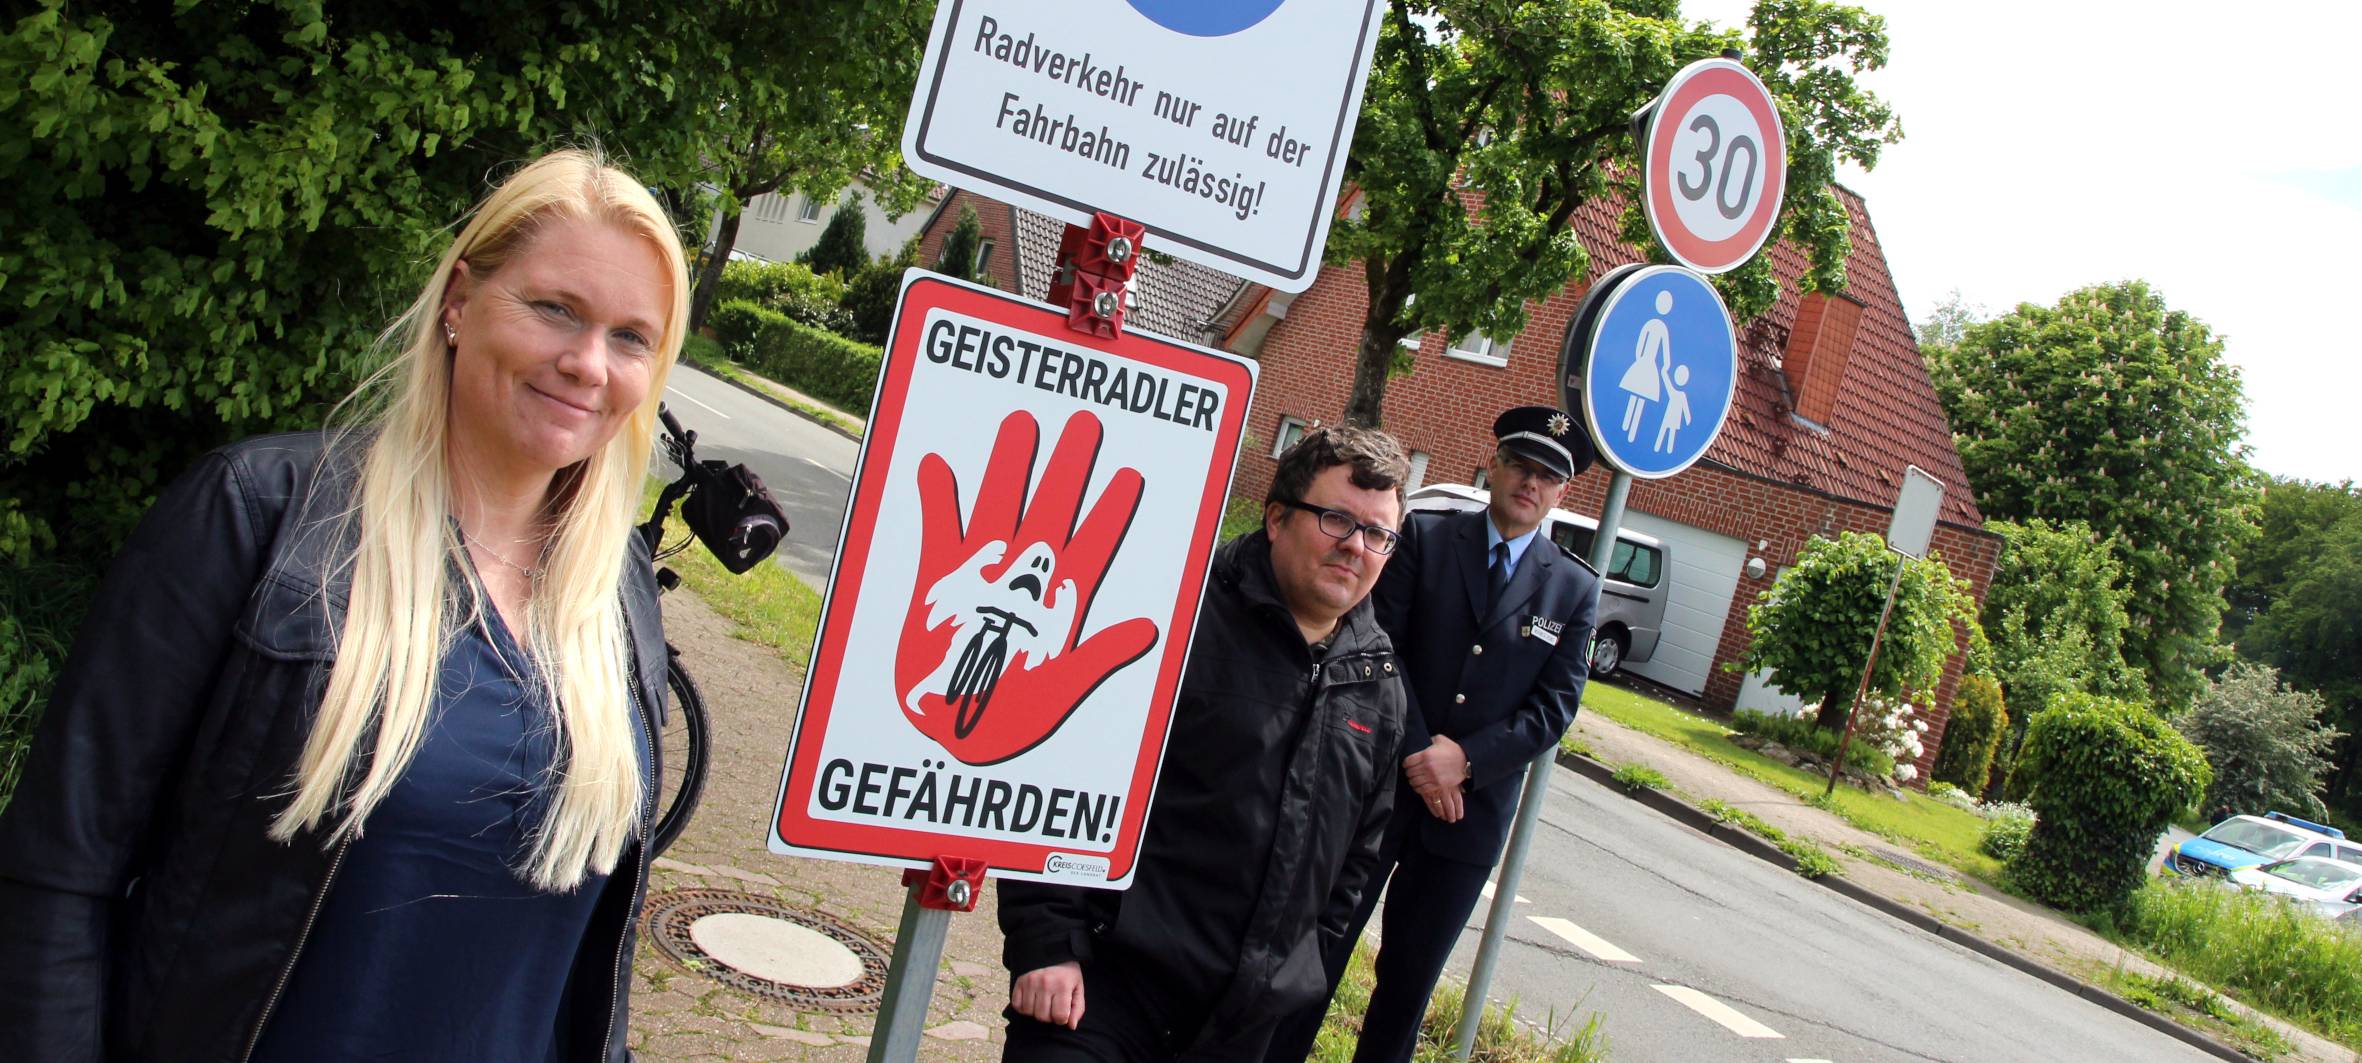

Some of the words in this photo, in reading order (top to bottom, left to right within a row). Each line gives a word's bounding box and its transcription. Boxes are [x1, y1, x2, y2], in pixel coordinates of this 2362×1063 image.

[974, 15, 1144, 107] Radverkehr
[1153, 90, 1202, 129] nur
[1212, 113, 1259, 148] auf
[1266, 125, 1311, 168] der
[996, 92, 1131, 170] Fahrbahn
[1141, 153, 1266, 221] zulässig!
[1677, 114, 1758, 220] 30
[926, 319, 1219, 432] GEISTERRADLER
[1531, 615, 1563, 634] POLIZEI
[818, 758, 1121, 844] GEFÄHRDEN!
